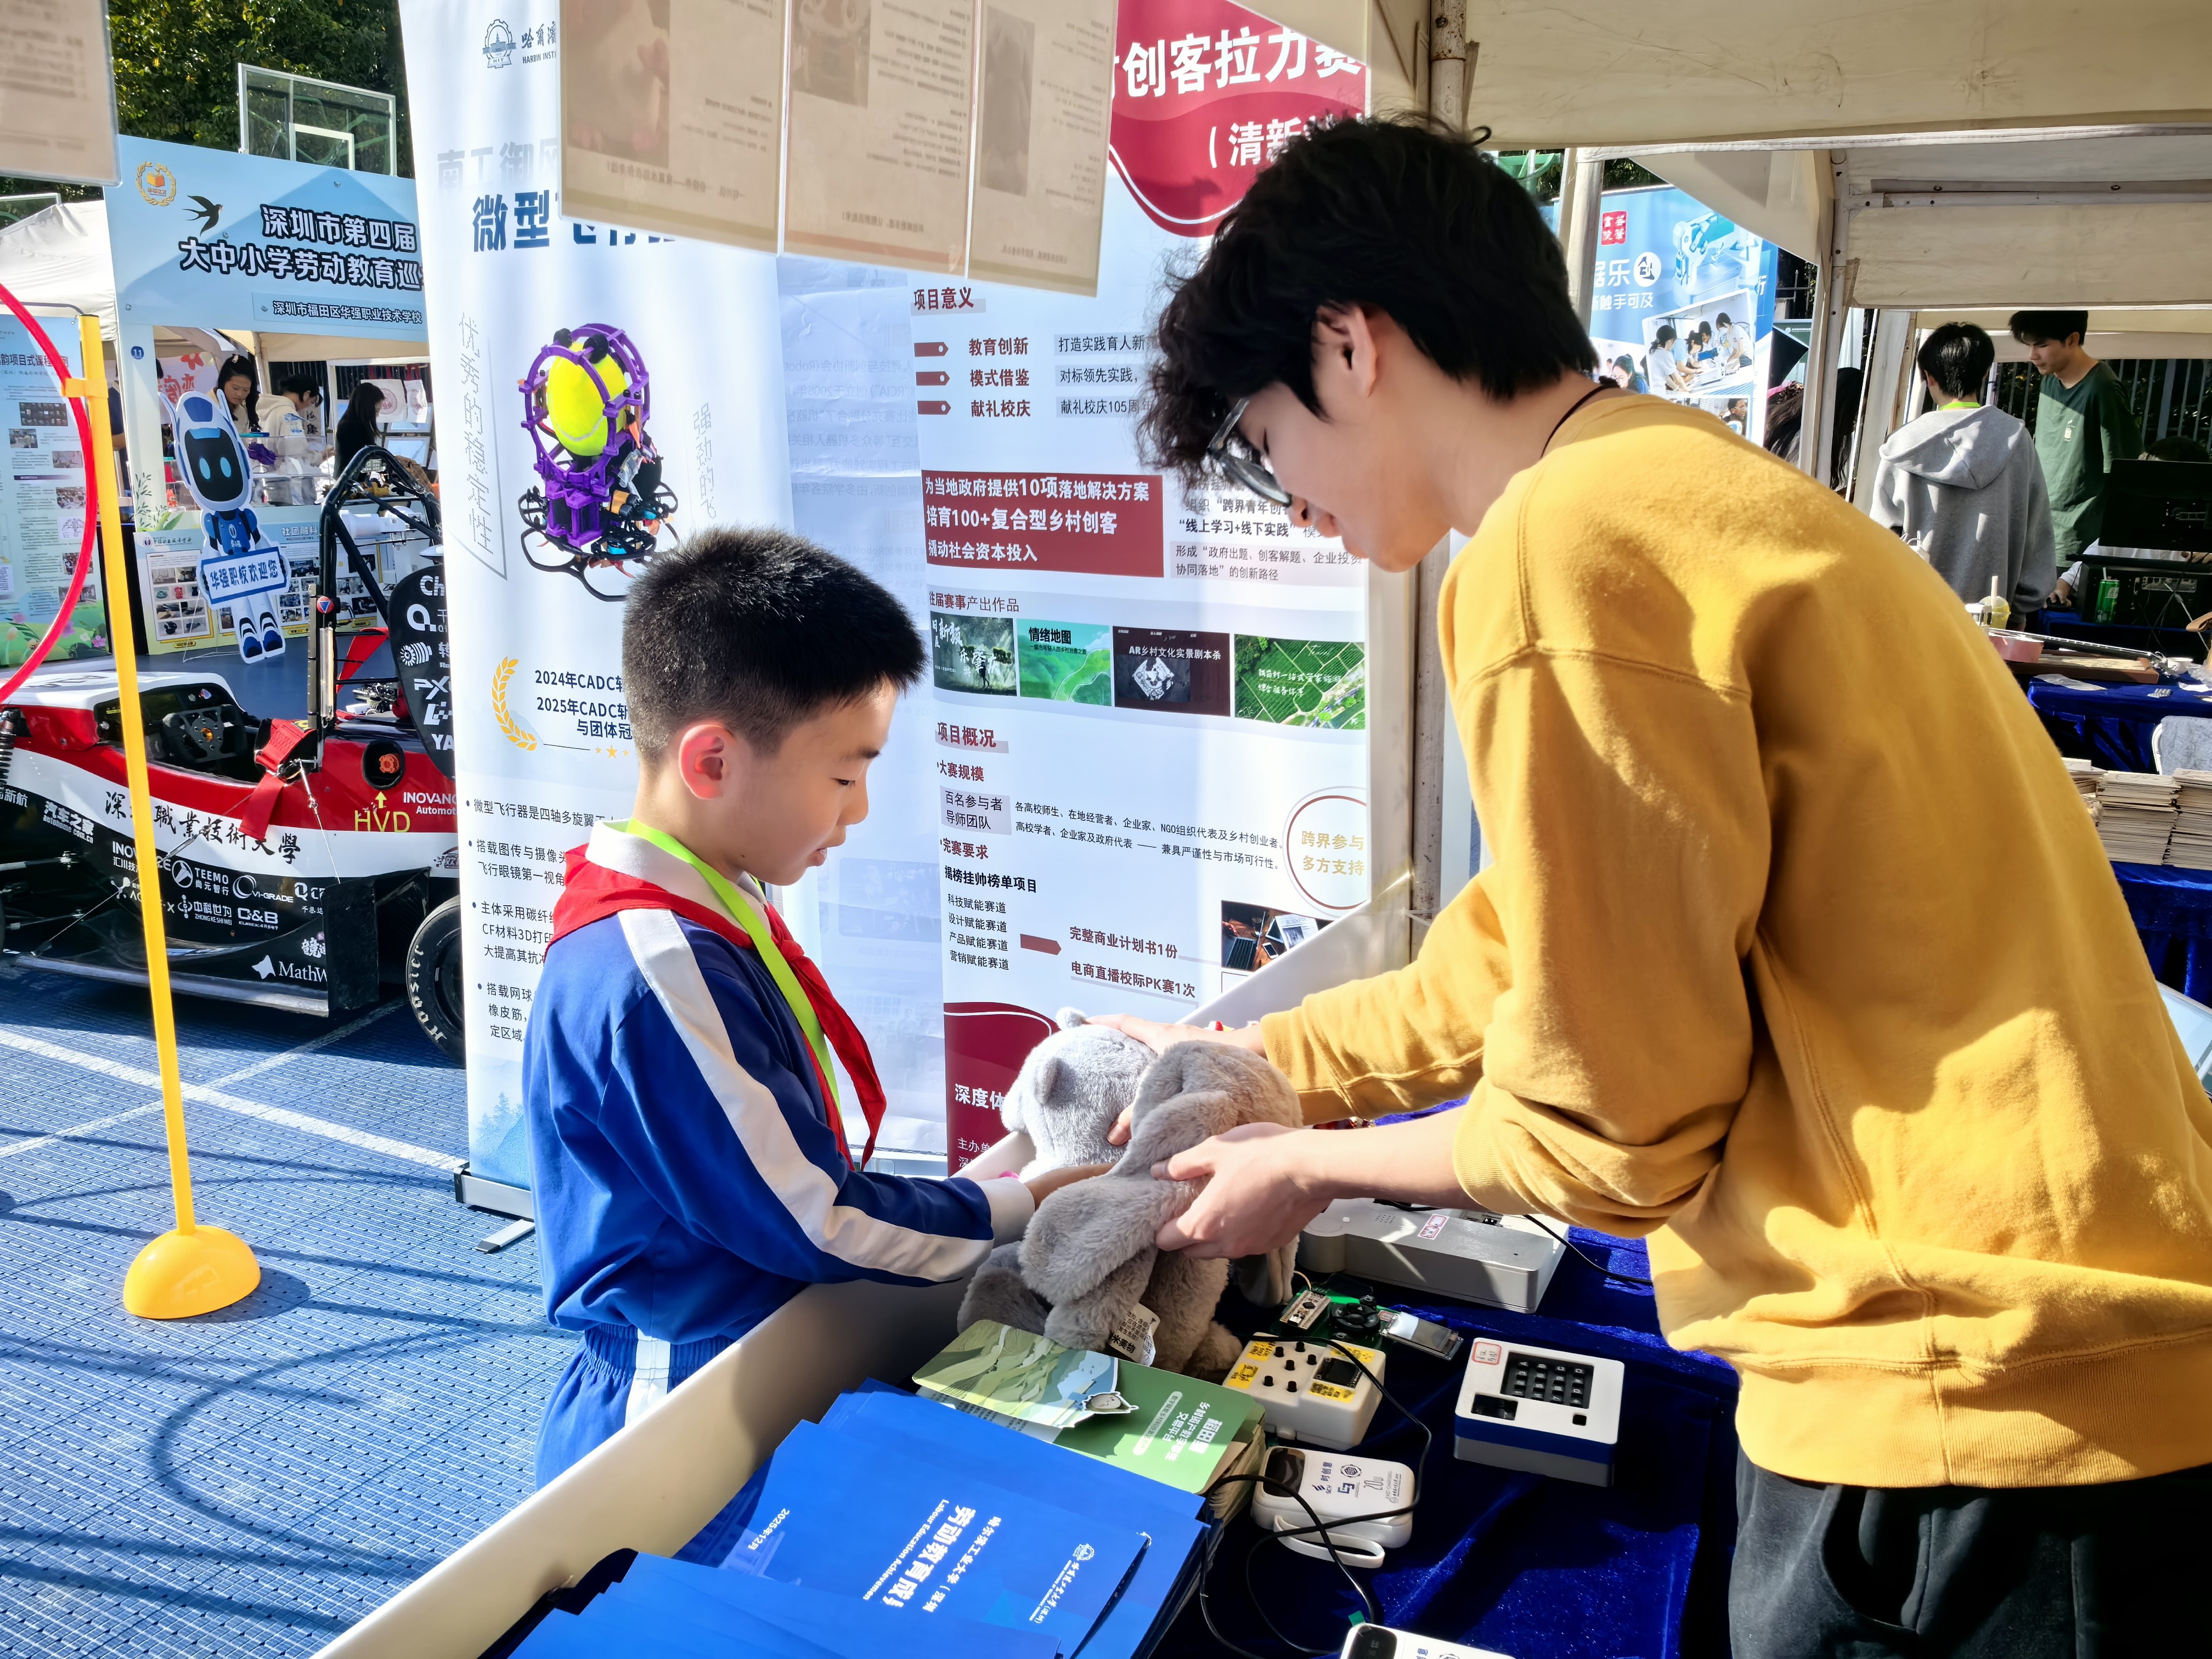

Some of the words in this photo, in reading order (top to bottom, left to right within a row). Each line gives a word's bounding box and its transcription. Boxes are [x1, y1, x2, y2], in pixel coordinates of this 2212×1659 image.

[522, 55, 541, 64] HARBIN
[1112, 26, 1362, 100] 创客拉力赛
[261, 205, 417, 252] 深圳市第四届
[179, 237, 424, 290] 大中小学劳动教育巡
[914, 286, 974, 311] 项目意义
[273, 300, 423, 324] 深圳市福田区华强职业技术学校
[969, 337, 1029, 356] 教育创新
[0, 353, 69, 368] 韵项目式课程例
[970, 369, 1030, 387] 模式借鉴
[971, 400, 1031, 417] 献礼校庆
[925, 476, 1149, 502] 为当地政府提供10项落地解决方案
[927, 506, 1117, 535] 培育100+复合型乡村创客
[928, 538, 1037, 562] 撬动社会资本投入
[210, 558, 279, 591] 华强职校欢迎您
[1176, 563, 1279, 582] 协同落地”的创新路径
[929, 590, 1020, 612] 往届赛事产出作品
[1029, 626, 1071, 645] 情绪地图
[1129, 645, 1221, 660] AR乡村文化实景剧本杀
[577, 719, 632, 739] 与团体冠
[938, 722, 996, 748] 项目概况
[939, 760, 984, 782] 大赛规模
[945, 790, 1003, 812] 百名参与者
[43, 800, 95, 836] 汽车之家
[354, 810, 410, 833] HVD
[474, 799, 605, 827] 微型飞行器是四轴多旋翼
[946, 810, 991, 830] 导师团队
[105, 790, 301, 865] 深職業技術大學
[943, 838, 989, 860] 完赛要求
[1301, 830, 1364, 851] 跨界参与
[112, 841, 171, 871] INOCE
[113, 856, 138, 873] 汇川技
[1302, 855, 1365, 876] 多方支持
[195, 867, 229, 885] TEEMO
[478, 861, 564, 886] 飞行眼镜第一视角
[945, 865, 1036, 893] 揭榜挂帅榜单项目
[195, 879, 229, 896] 尚元智行
[252, 890, 294, 903] VI-GRADE
[194, 901, 232, 918] 中科世为
[948, 894, 1006, 914] 科技赋能赛道
[482, 923, 552, 944] CF材料3D打印
[948, 913, 1007, 933] 设计赋能赛道
[949, 932, 1008, 952] 产品赋能赛道
[1070, 926, 1178, 959] 完整商业计划书1份
[950, 950, 1009, 970] 营销赋能赛道
[1071, 961, 1196, 998] 电商直播校际PK赛1次
[955, 1083, 1004, 1112] 深度体
[957, 1137, 990, 1153] 主办单
[1320, 1462, 1332, 1482] 时创意
[925, 1497, 950, 1526] Labour
[747, 1508, 790, 1550] 2025年12月
[897, 1522, 930, 1559] Education
[862, 1556, 902, 1602] Achievemen
